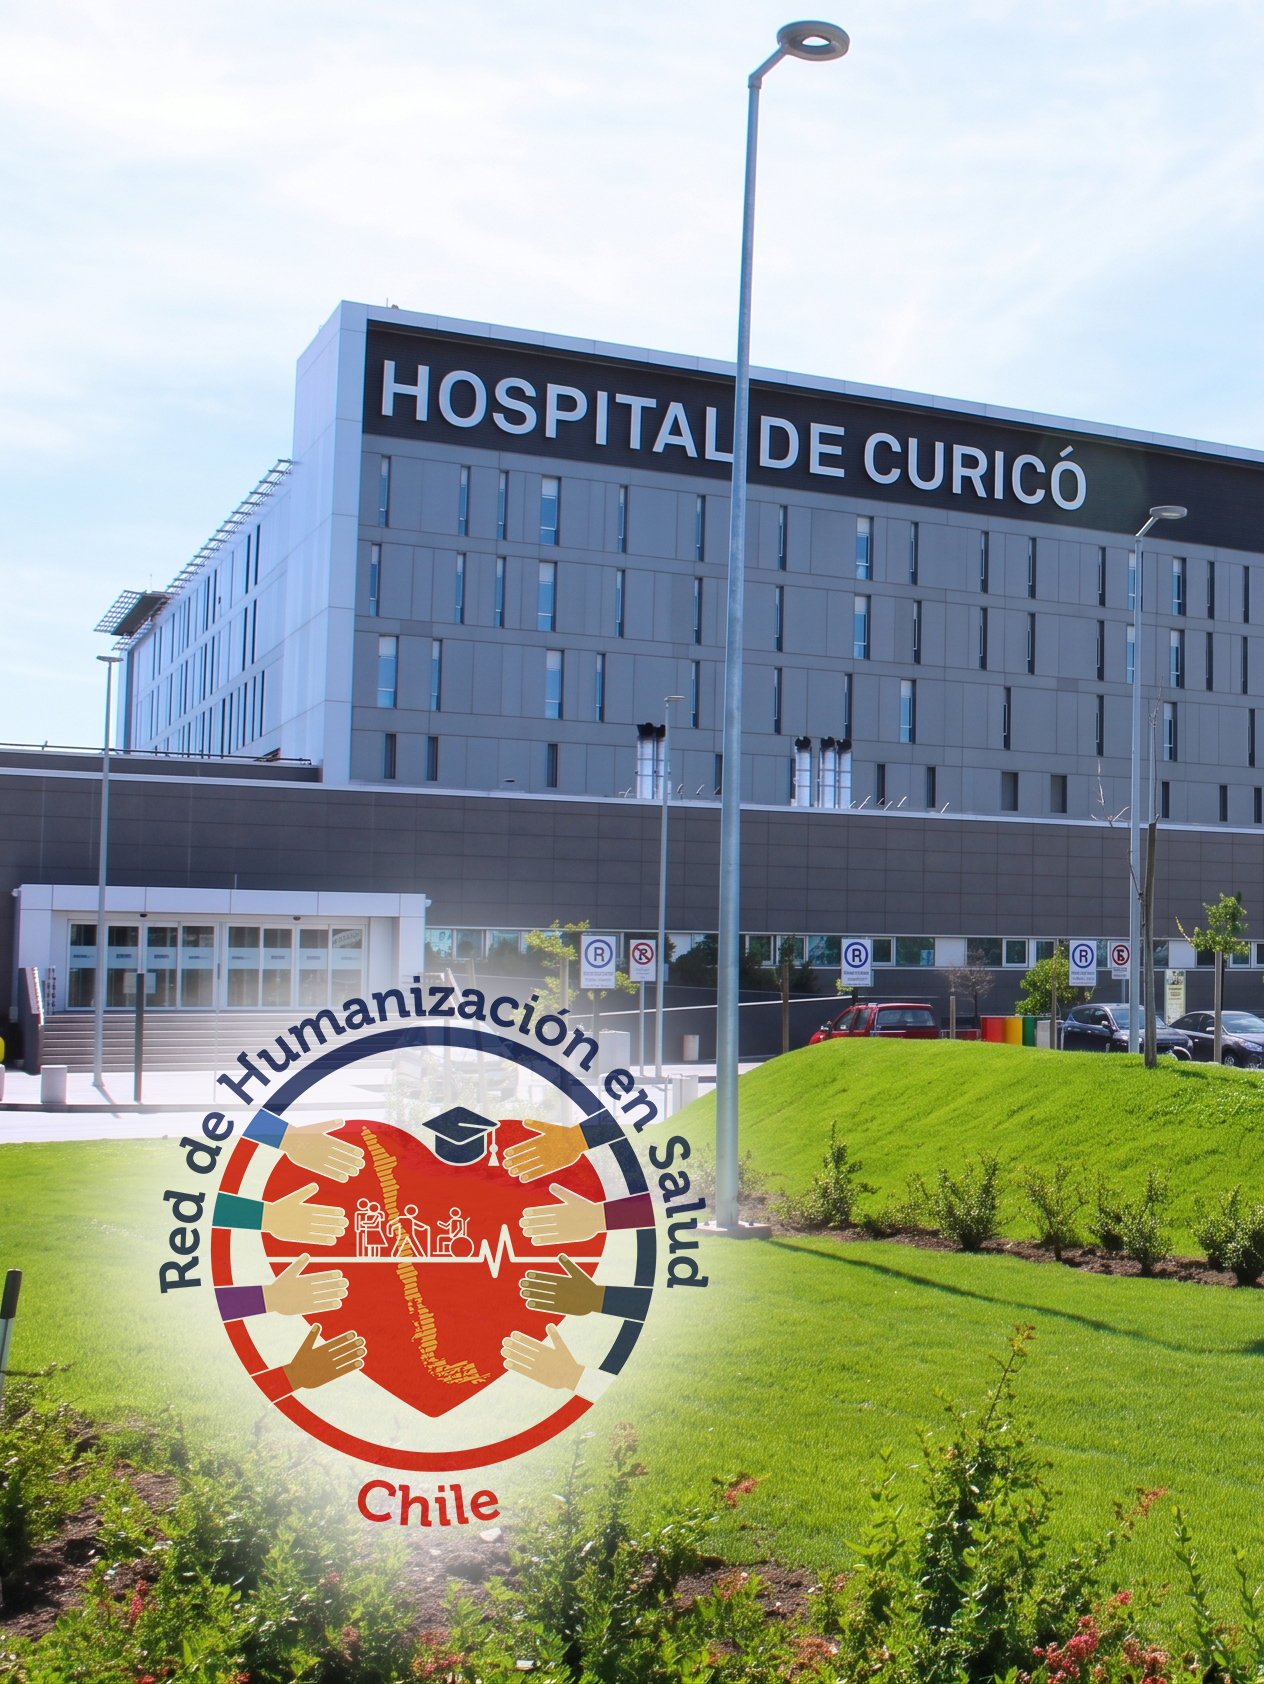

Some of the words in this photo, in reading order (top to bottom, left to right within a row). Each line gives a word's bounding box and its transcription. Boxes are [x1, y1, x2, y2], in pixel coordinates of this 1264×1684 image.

[382, 359, 735, 470] HOSPITAL
[759, 415, 845, 478] DE
[864, 432, 1087, 511] CURICÓ
[852, 948, 862, 963] R
[1079, 949, 1089, 963] R
